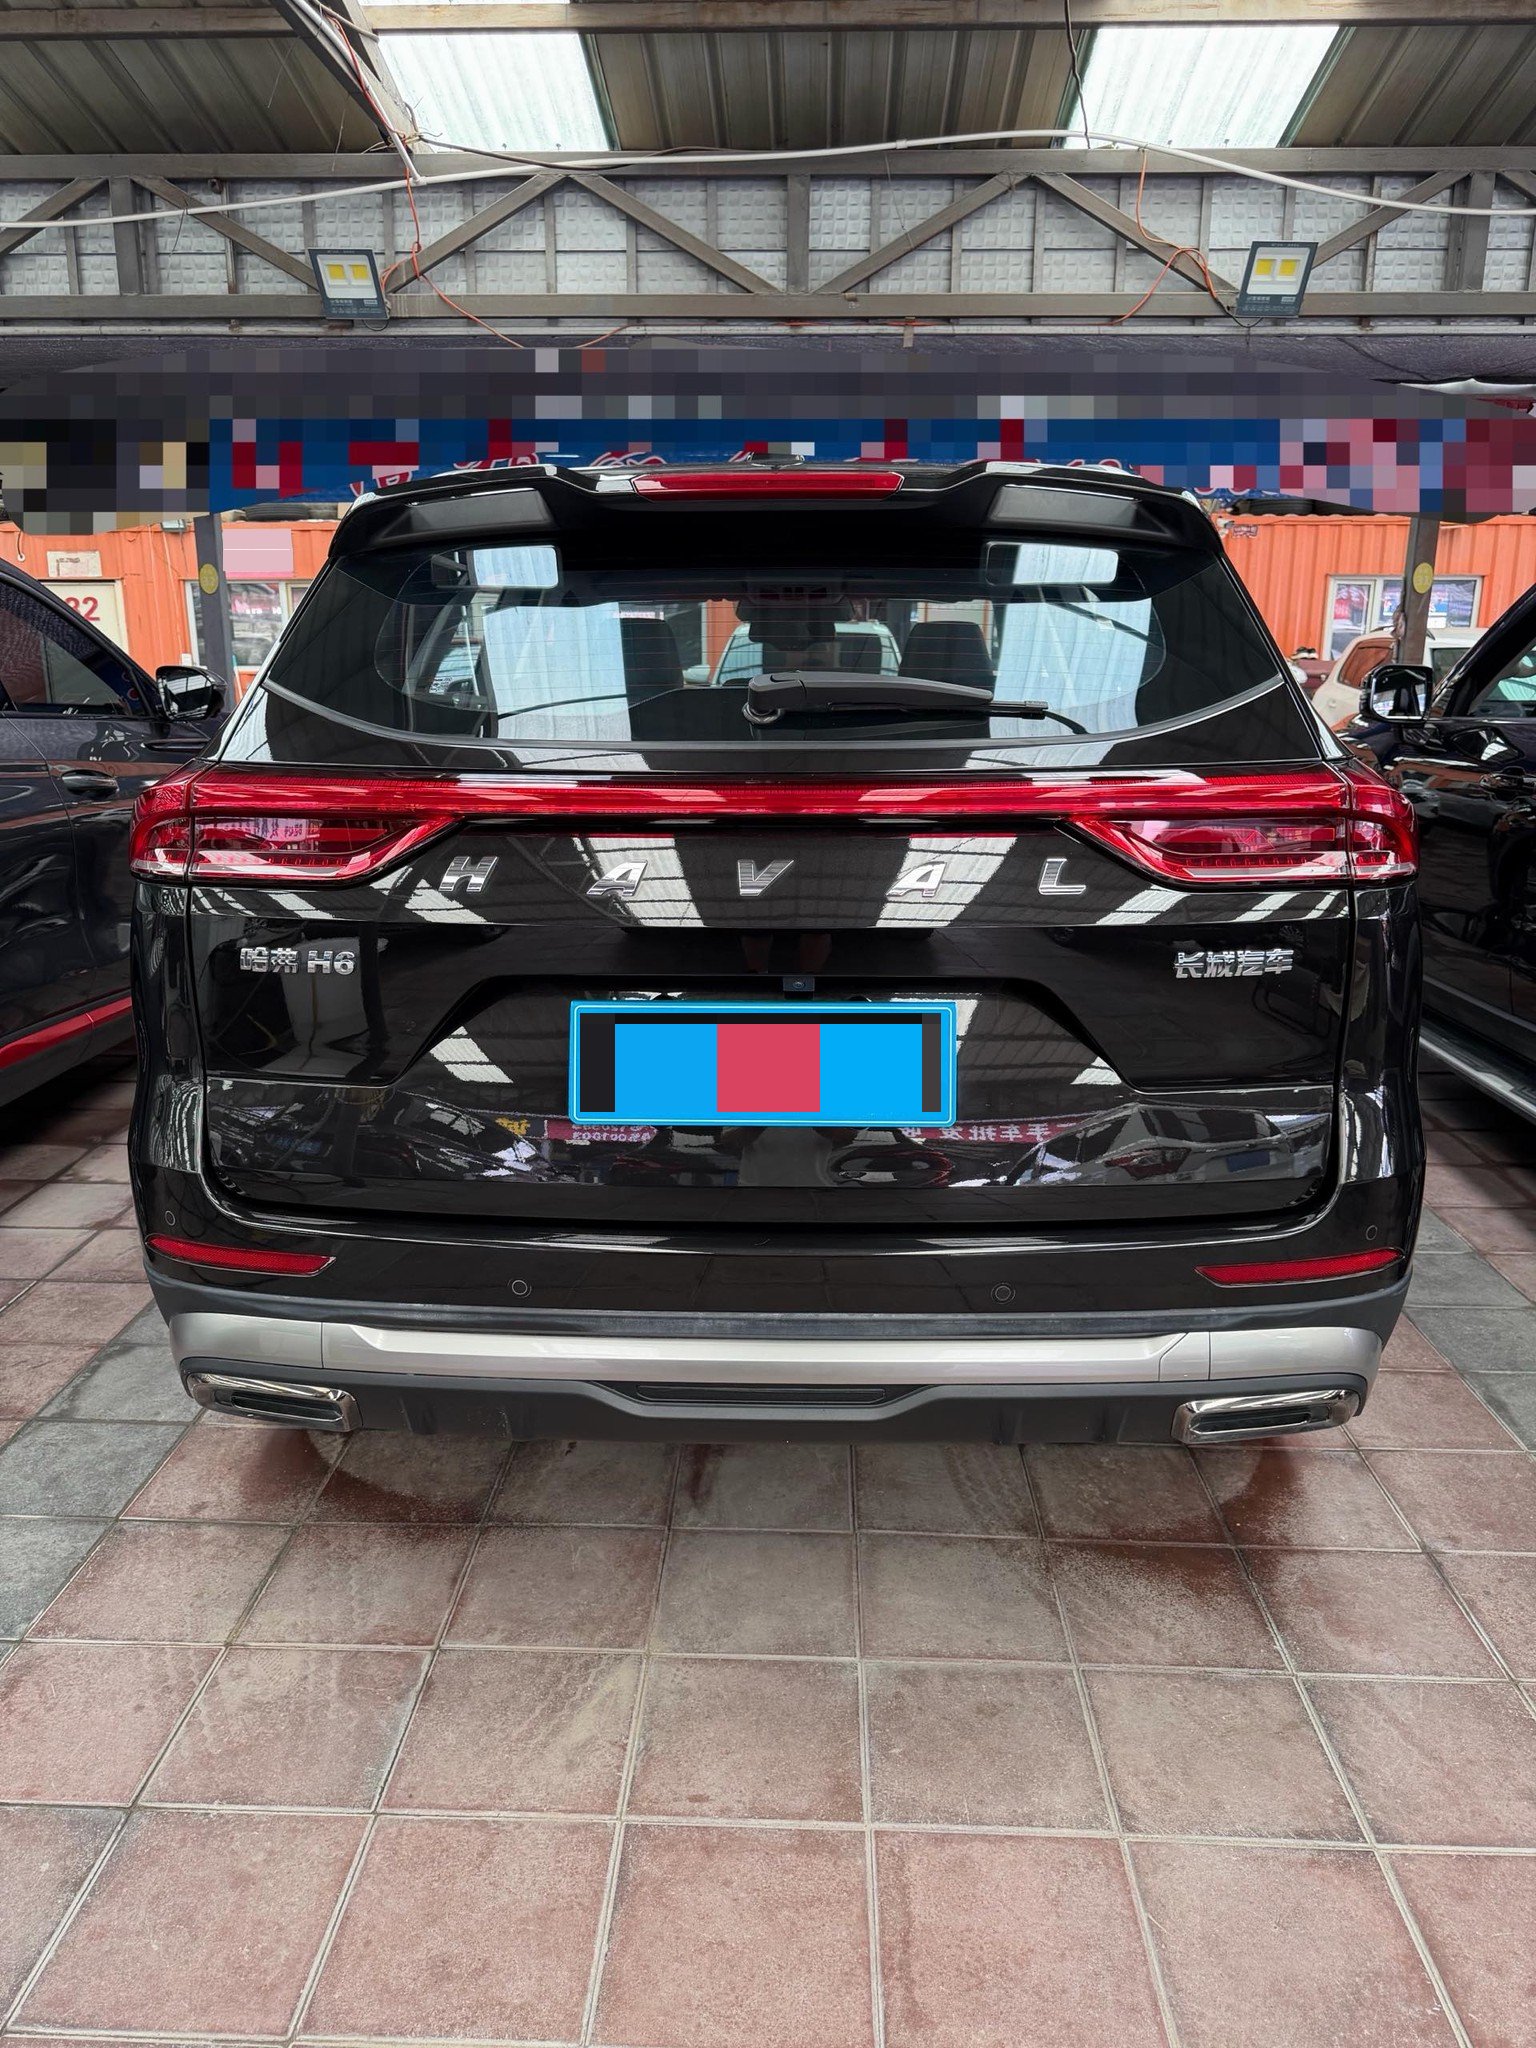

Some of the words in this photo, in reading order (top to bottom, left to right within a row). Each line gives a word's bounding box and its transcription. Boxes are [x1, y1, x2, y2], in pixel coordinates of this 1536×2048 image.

[438, 855, 1087, 897] HAVAL
[240, 947, 298, 973] 哈弗
[307, 950, 355, 975] H6
[1174, 948, 1294, 978] 长城汽车
